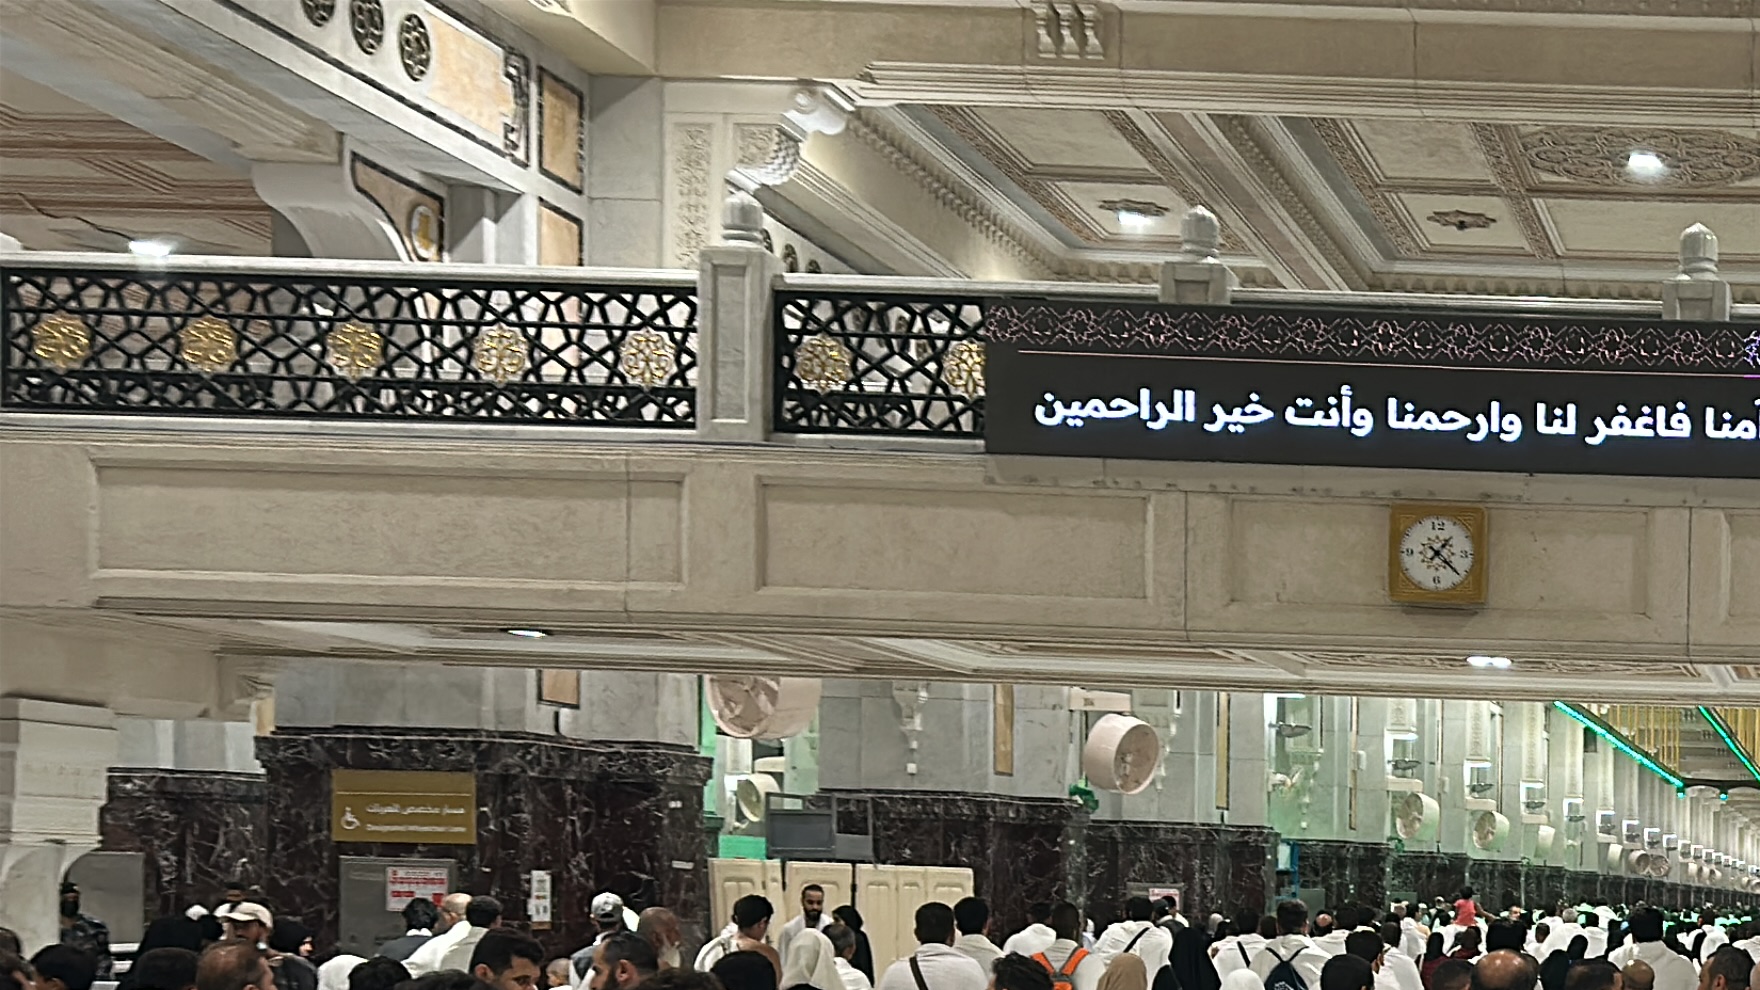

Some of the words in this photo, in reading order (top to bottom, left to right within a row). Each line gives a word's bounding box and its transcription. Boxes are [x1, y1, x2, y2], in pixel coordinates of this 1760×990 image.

[1033, 387, 1197, 430] الراحمين
[1202, 392, 1276, 433] خير
[1283, 384, 1375, 437] وأنت
[1386, 397, 1524, 443] وارحمنا
[1535, 402, 1578, 435] لنا
[1584, 401, 1693, 446] فاغفر
[1431, 521, 1445, 531] 12
